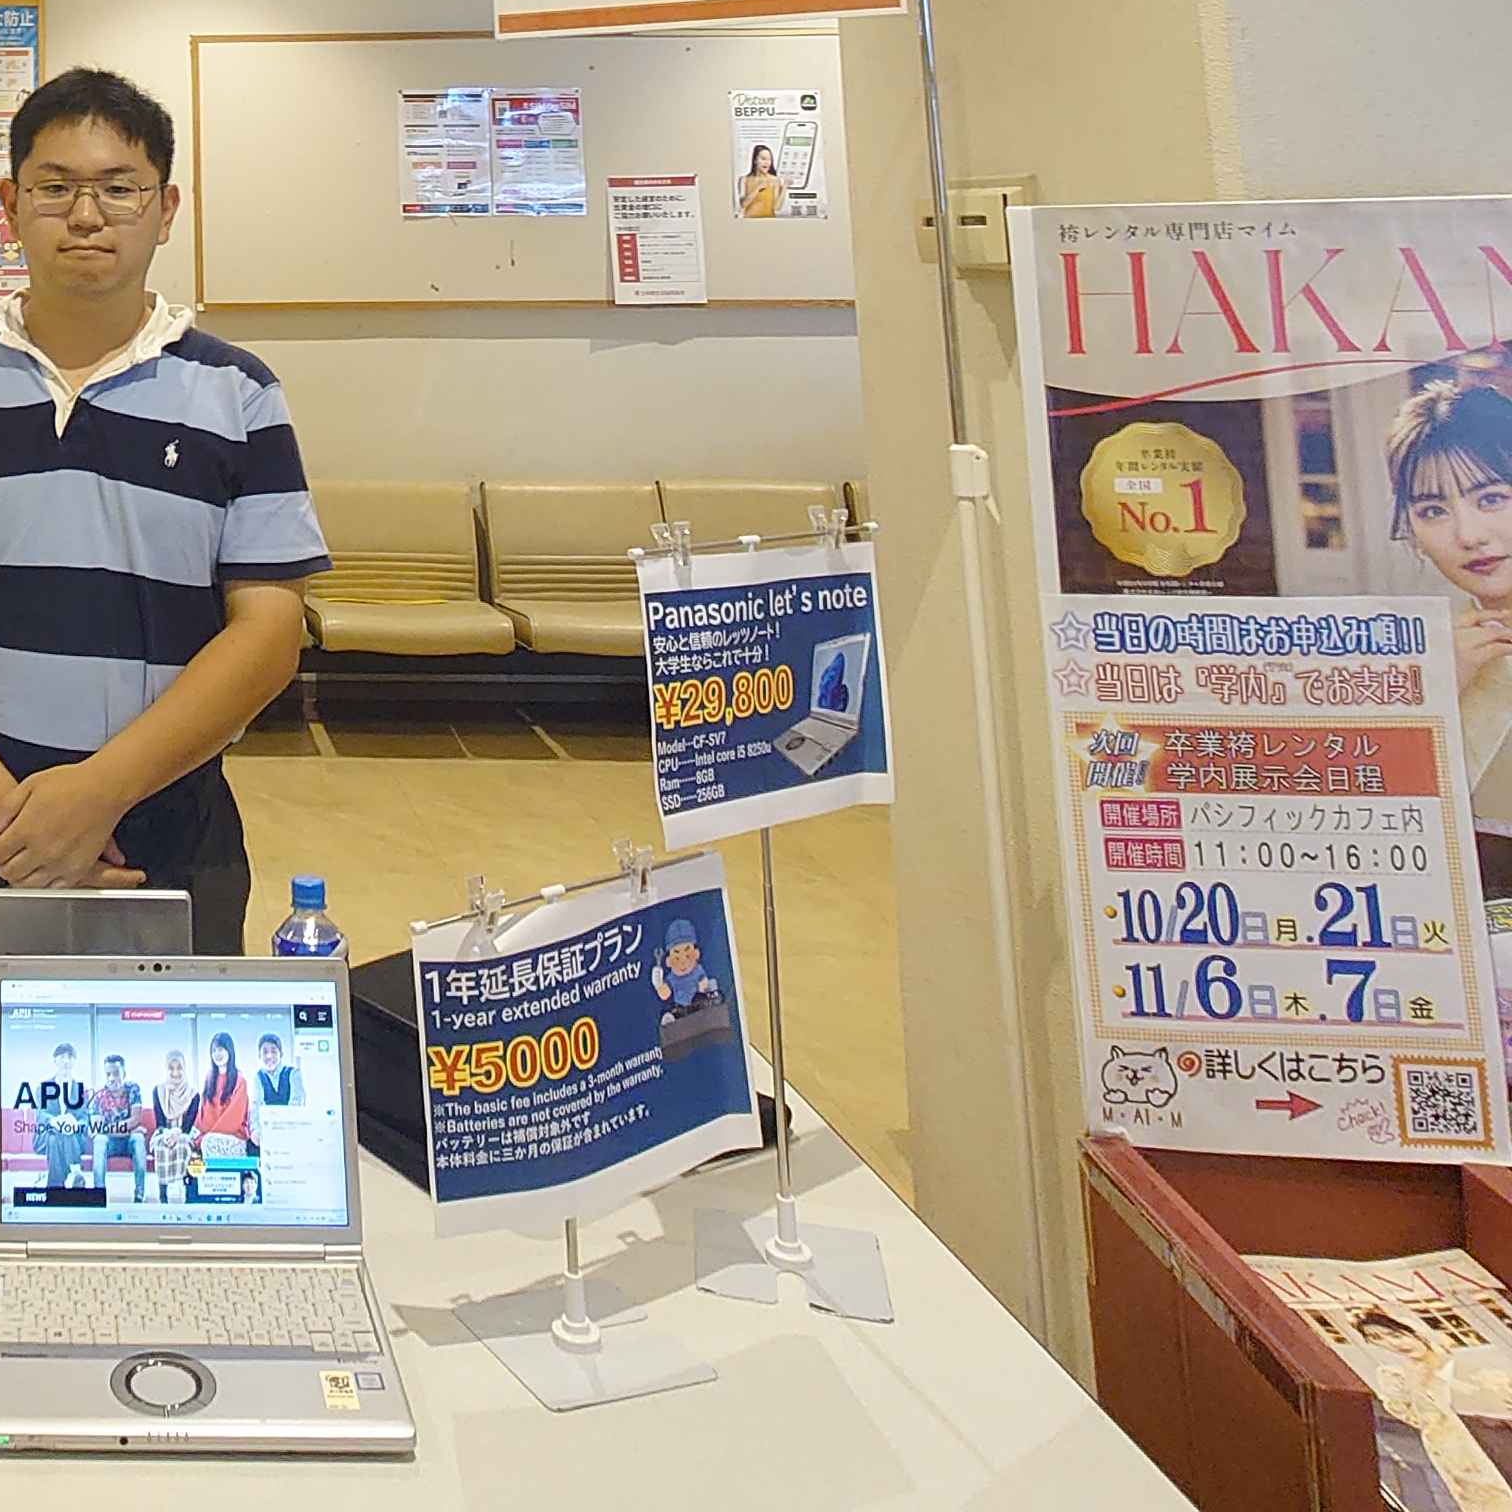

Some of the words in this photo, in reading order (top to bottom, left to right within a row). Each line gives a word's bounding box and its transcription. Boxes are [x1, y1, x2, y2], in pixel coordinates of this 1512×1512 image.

[734, 107, 776, 117] BEPPU
[1057, 221, 1296, 243] 袴レンタル専門店マイム
[1117, 478, 1218, 534] No.1
[648, 592, 765, 631] Panasonic
[818, 583, 868, 610] note
[716, 750, 736, 762] core
[1089, 728, 1140, 757] 次回
[1164, 729, 1380, 758] 卒業袴レンタル
[1166, 762, 1385, 793] 学内展示会日程
[1102, 802, 1181, 828] 開催場所
[1190, 802, 1424, 834] パシフィックカフェ内
[1107, 841, 1183, 869] 開催時間
[425, 923, 643, 1006] 1年延長保証プラン
[431, 1008, 496, 1030] 1-year
[502, 989, 581, 1023] extended
[583, 960, 642, 1000] warranty
[427, 1016, 599, 1097] ¥5000
[1204, 1048, 1386, 1084] 詳しくはこちら
[14, 1081, 84, 1110] APU
[474, 1099, 508, 1115] basic
[511, 1096, 531, 1110] fee
[533, 1083, 578, 1106] includes
[579, 1083, 587, 1092] a
[588, 1062, 625, 1089] 3-month
[625, 1046, 663, 1070] warranty
[508, 1114, 528, 1127] are
[530, 1108, 551, 1124] not
[552, 1095, 592, 1119] covered
[593, 1088, 606, 1104] by
[607, 1083, 622, 1098] the
[14, 1119, 53, 1137] Shape
[57, 1120, 86, 1134] Your
[89, 1119, 131, 1135] World.
